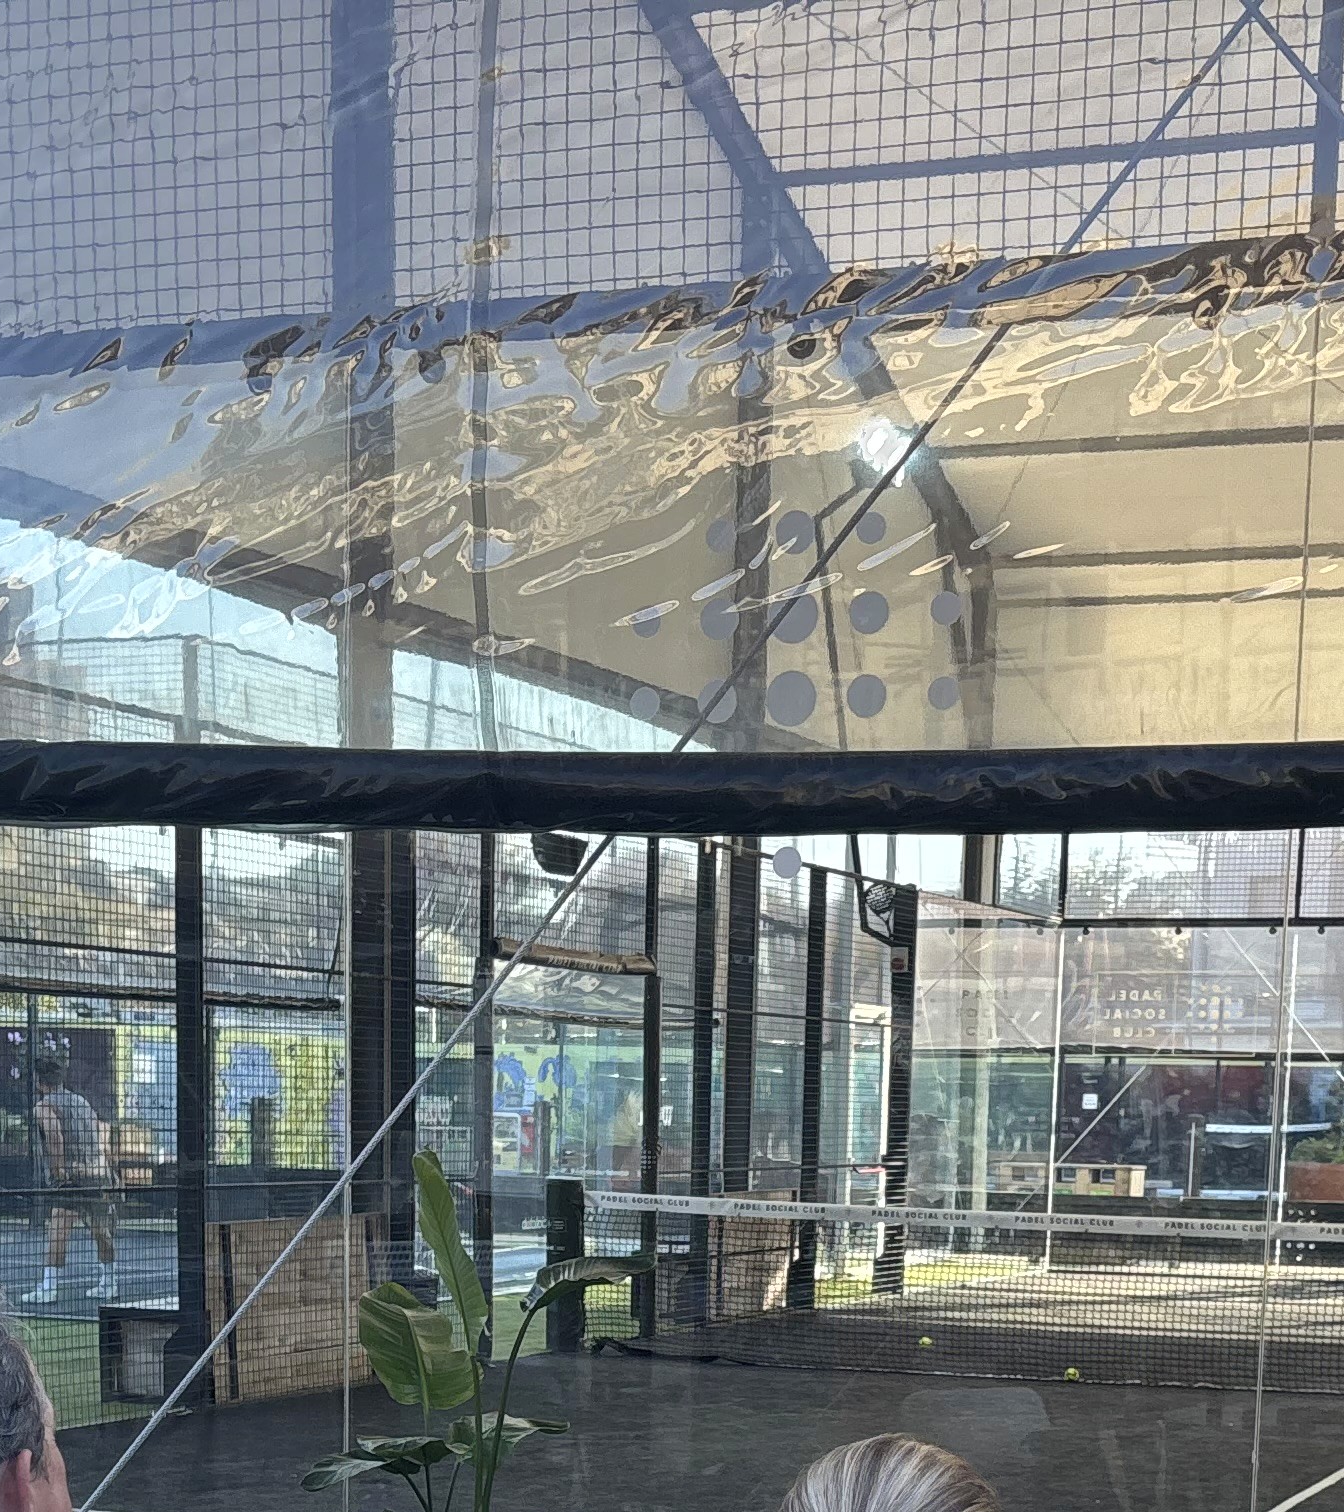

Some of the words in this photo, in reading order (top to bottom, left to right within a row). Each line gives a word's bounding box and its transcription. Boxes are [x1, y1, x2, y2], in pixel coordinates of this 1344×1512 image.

[765, 1203, 799, 1213] SOCIAL
[802, 1205, 826, 1214] CLUB
[1014, 1215, 1045, 1225] PADEL
[1049, 1216, 1084, 1226] SOCIAL
[1089, 1218, 1114, 1227] CLUB
[1164, 1221, 1196, 1230] PADEL
[1200, 1222, 1237, 1231] SOCIAL
